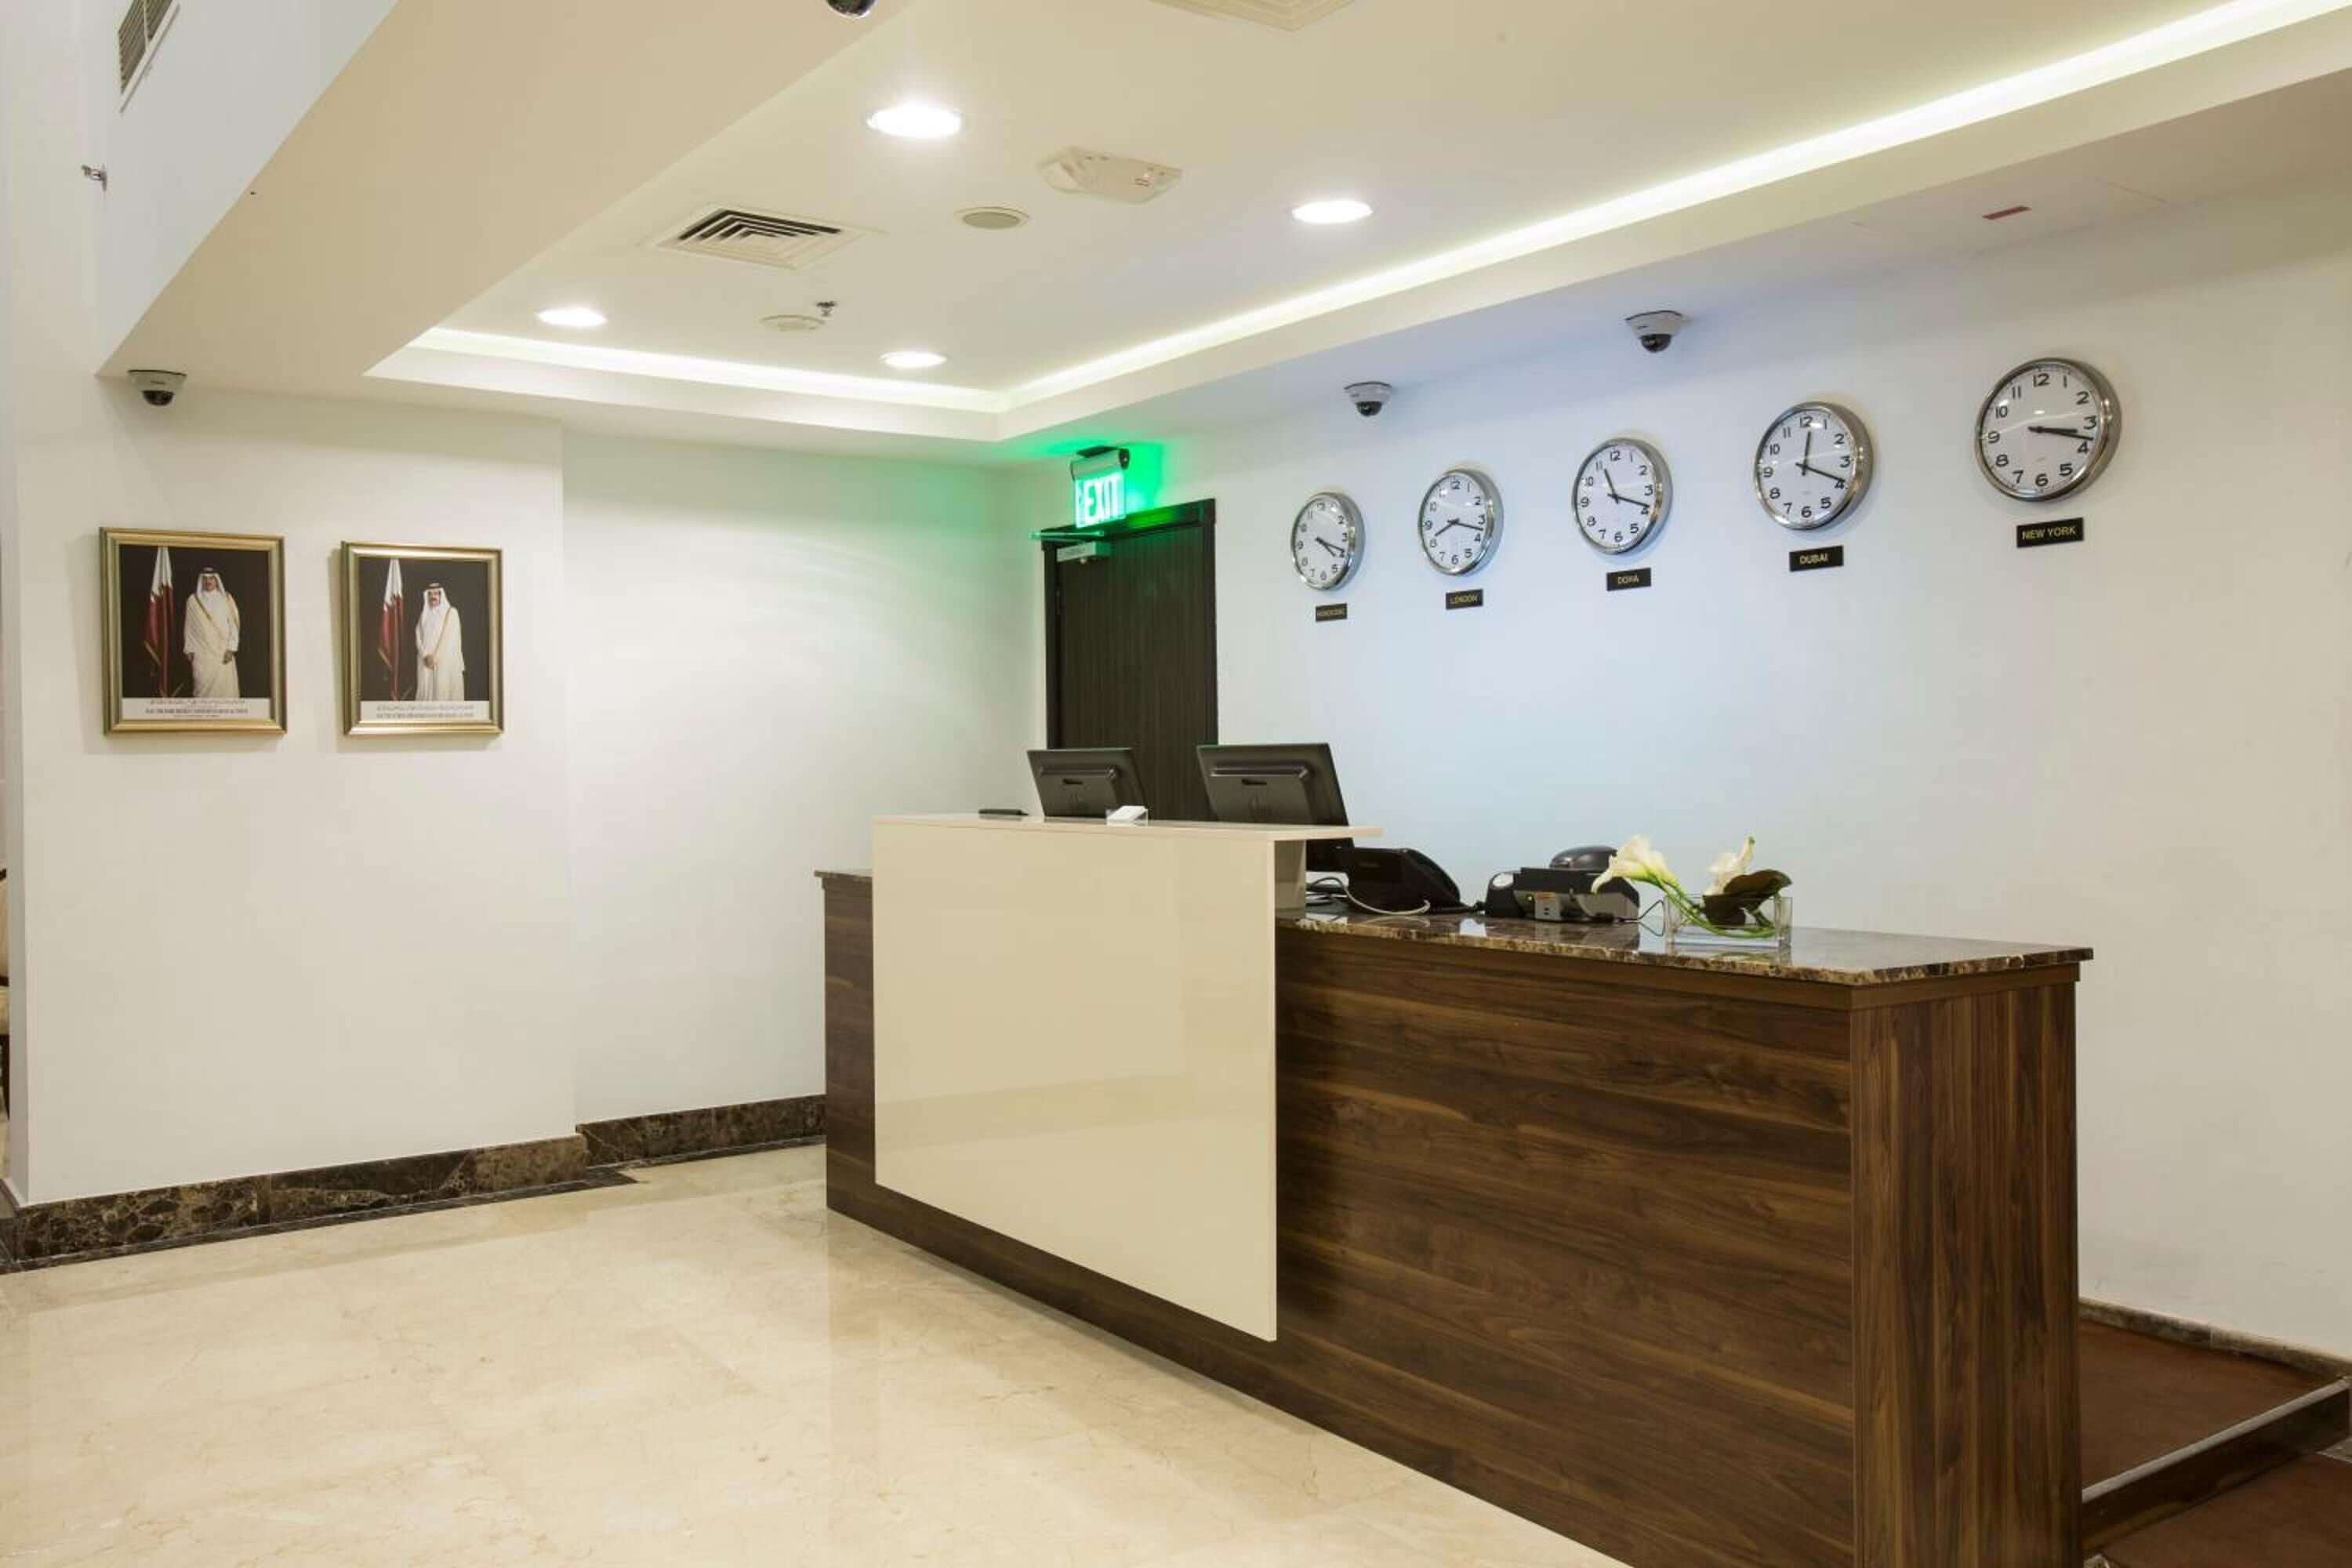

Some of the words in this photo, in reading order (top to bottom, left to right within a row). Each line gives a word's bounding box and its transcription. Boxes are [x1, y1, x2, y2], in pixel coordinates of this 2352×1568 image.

[2034, 373, 2049, 387] 12
[2063, 376, 2067, 389] 1
[2012, 386, 2021, 399] 11
[2076, 391, 2089, 405] 2
[1995, 405, 2008, 419] 10
[1799, 416, 1813, 428] 12
[2084, 416, 2096, 430] 3
[1783, 426, 1791, 438] 11
[1987, 431, 2000, 444] 9
[1834, 434, 1845, 444] 2
[1769, 444, 1780, 456] 10
[2077, 441, 2089, 454] 4
[1610, 450, 1621, 462] 12
[1995, 455, 2009, 466] 8
[1595, 461, 1603, 472] 11
[1840, 456, 1850, 468] 3
[1639, 465, 1647, 475] 2
[1763, 466, 1773, 477] 9
[2059, 463, 2073, 476] 5
[2013, 470, 2024, 483] 7
[2035, 474, 2049, 487] 6
[1451, 479, 1461, 490] 12
[1835, 479, 1845, 489] 4
[1644, 485, 1653, 496] 3
[1769, 488, 1780, 499] 8
[1083, 474, 1122, 524] EXIT
[1474, 496, 1481, 506] 2
[1581, 497, 1589, 508] 9
[1820, 497, 1831, 509] 5
[1429, 501, 1437, 512] 10
[1784, 503, 1792, 514] 7
[1802, 506, 1812, 517] 6
[1478, 514, 1485, 524] 3
[1586, 516, 1596, 527] 8
[1425, 521, 1432, 531] 9
[1631, 523, 1639, 534] 5
[1474, 534, 1481, 543] 4
[1599, 528, 1606, 539] 7
[1614, 532, 1623, 543] 6
[2022, 529, 2045, 540] NEW
[2047, 526, 2076, 538] YORK
[1430, 539, 1437, 548] 8
[1439, 551, 1445, 561] 7
[1465, 548, 1472, 558] 5
[1799, 553, 1828, 564] DUBAI
[1451, 554, 1459, 564] 6
[1618, 574, 1640, 585] DOHA
[1449, 593, 1479, 604] LONDON
